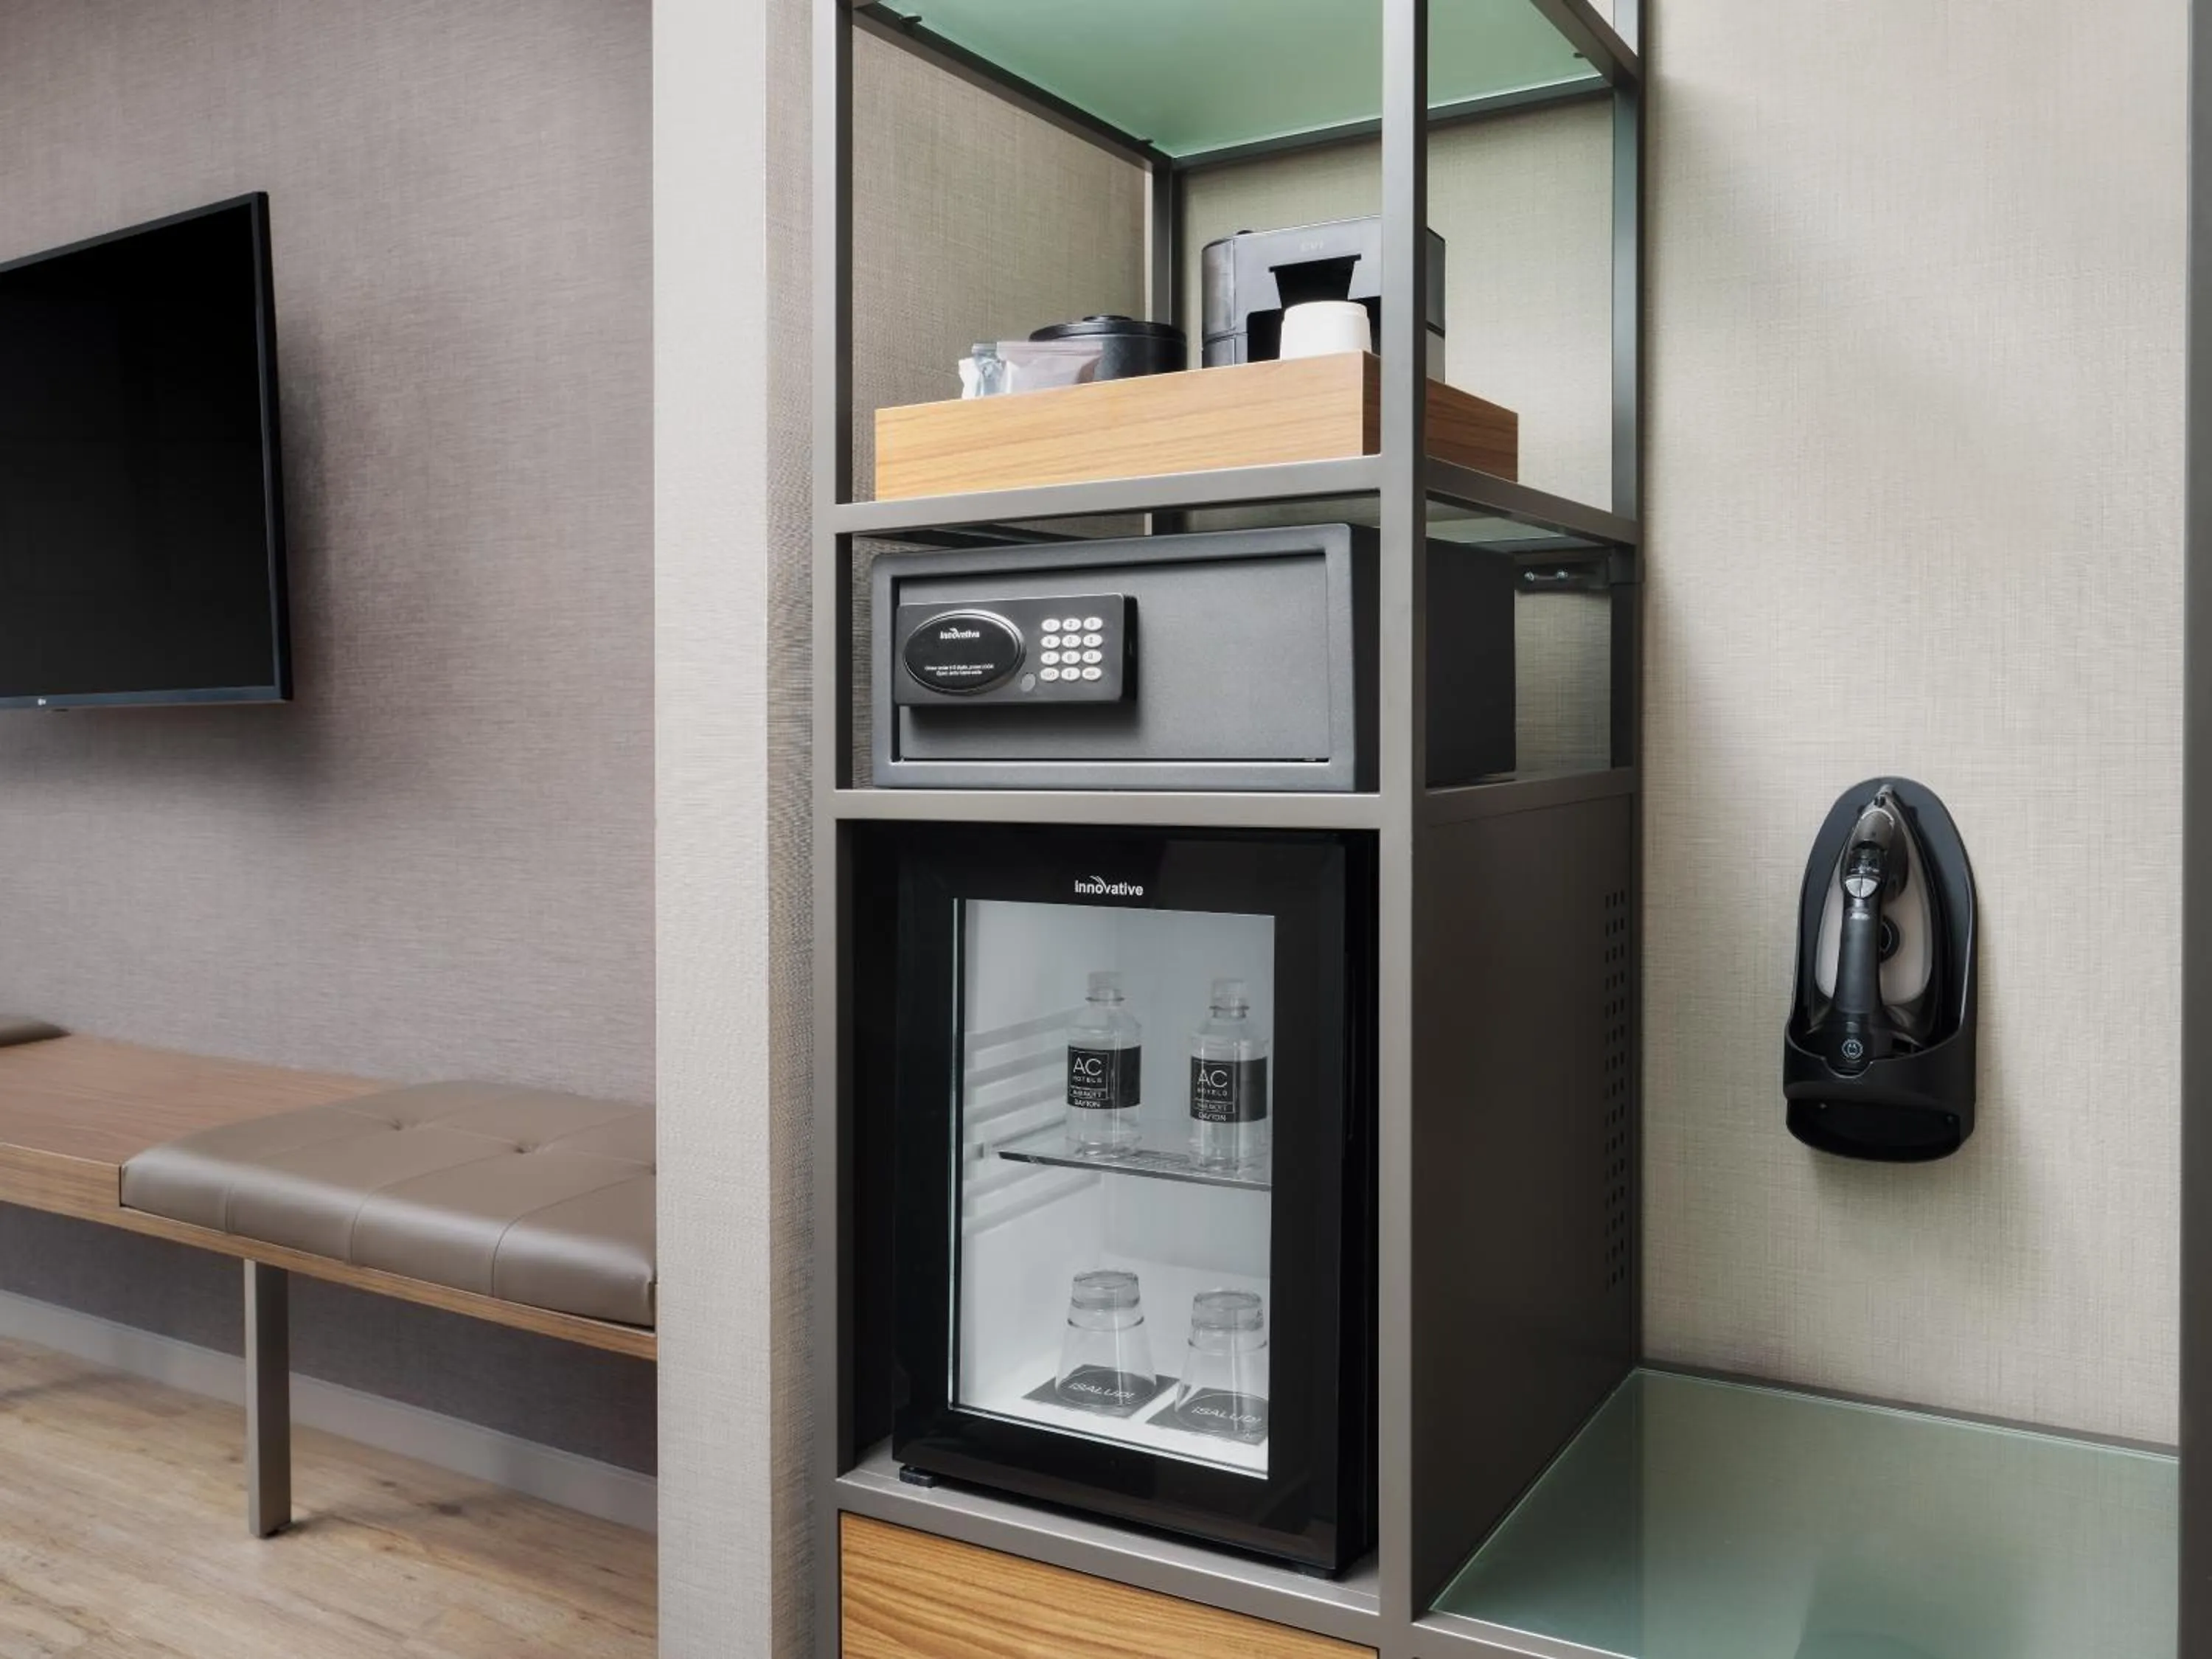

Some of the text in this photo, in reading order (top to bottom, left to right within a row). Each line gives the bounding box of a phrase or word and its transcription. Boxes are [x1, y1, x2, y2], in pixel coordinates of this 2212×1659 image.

[1074, 876, 1144, 896] Innovative
[1073, 1057, 1102, 1076] AC
[1197, 1068, 1228, 1088] AC
